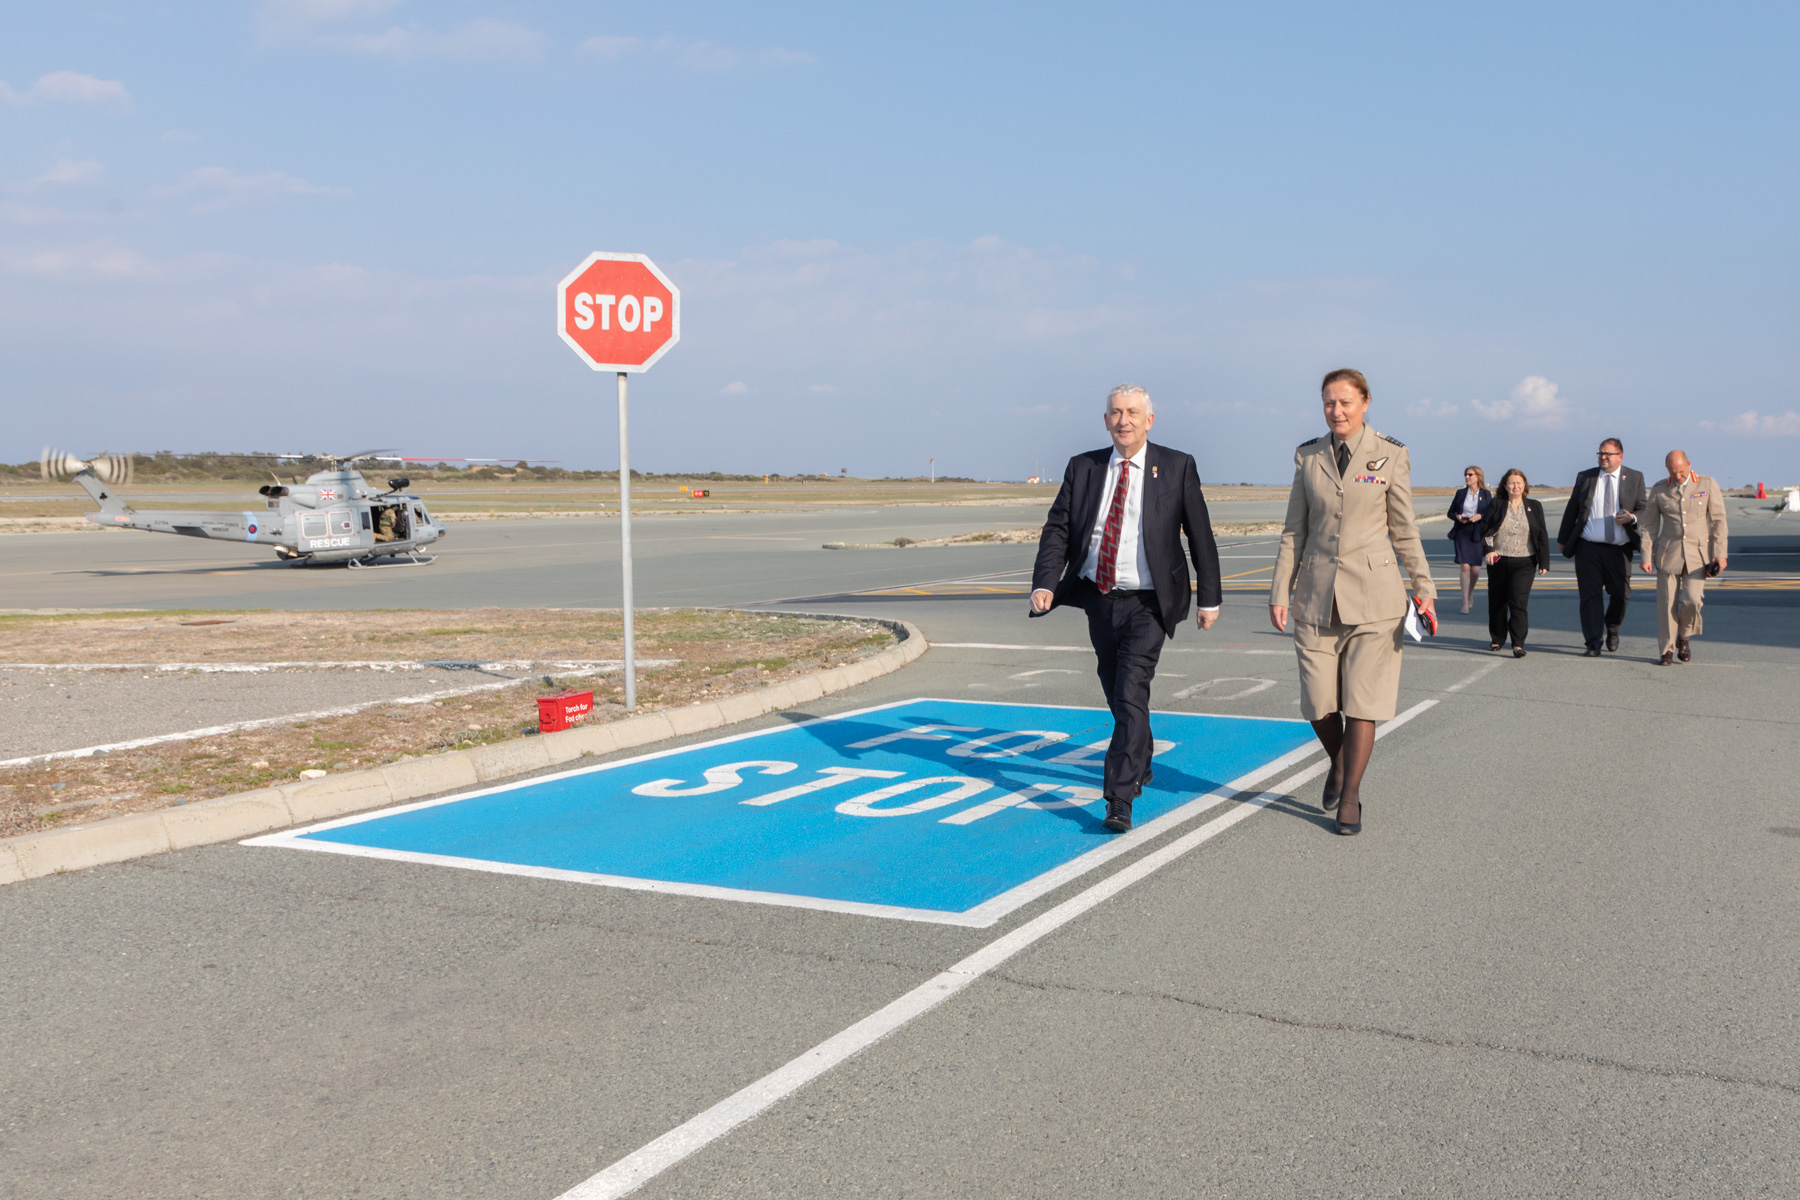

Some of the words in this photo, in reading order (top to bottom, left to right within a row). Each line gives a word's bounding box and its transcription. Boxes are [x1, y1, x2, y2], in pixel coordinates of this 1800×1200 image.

[574, 292, 663, 332] STOP
[310, 538, 350, 548] RESCUE
[565, 704, 579, 714] Torch
[580, 703, 588, 711] for
[631, 760, 1104, 826] STOP
